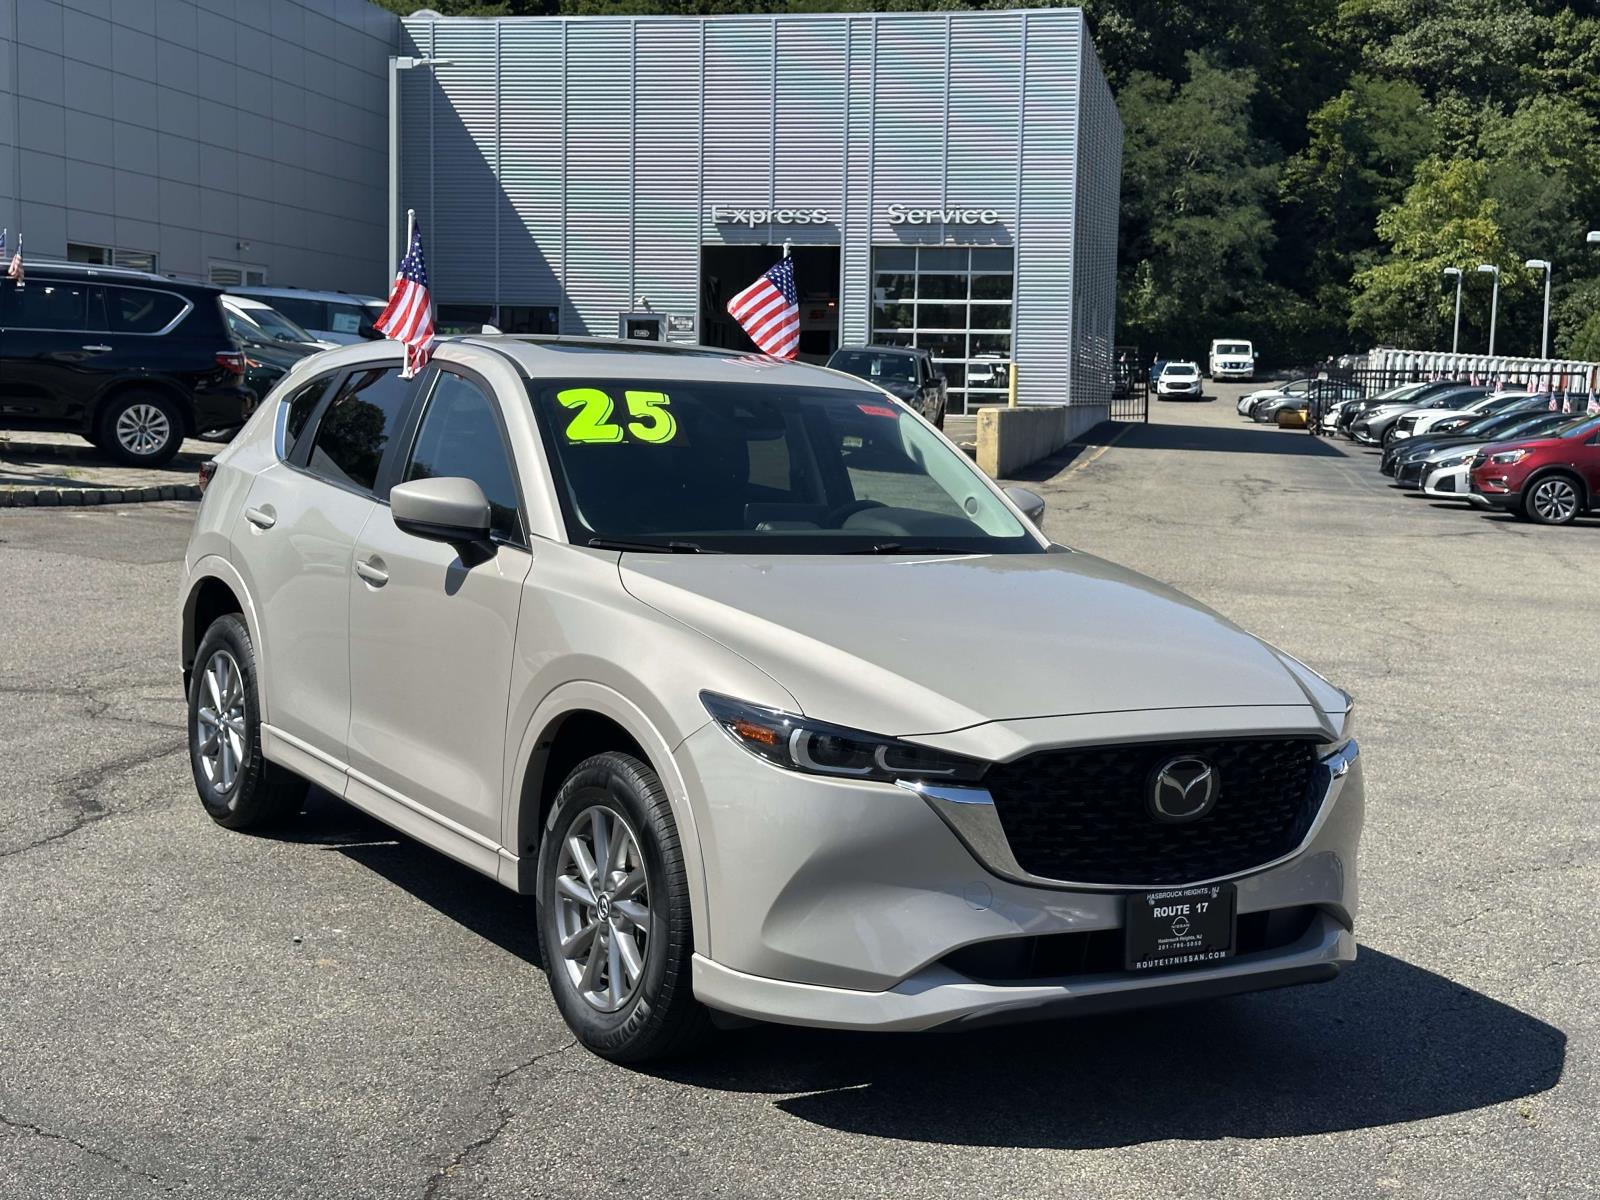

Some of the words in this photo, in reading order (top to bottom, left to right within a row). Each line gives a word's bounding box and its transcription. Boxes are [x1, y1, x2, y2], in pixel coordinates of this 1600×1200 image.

[711, 204, 829, 228] Express
[887, 203, 998, 225] Service
[557, 388, 677, 444] 25
[1147, 891, 1182, 900] HASBROUCK
[1212, 886, 1220, 894] NJ
[1153, 904, 1190, 918] ROUTE
[1196, 902, 1209, 913] 17
[1136, 951, 1226, 969] ROUTE17NISSAN.COM
